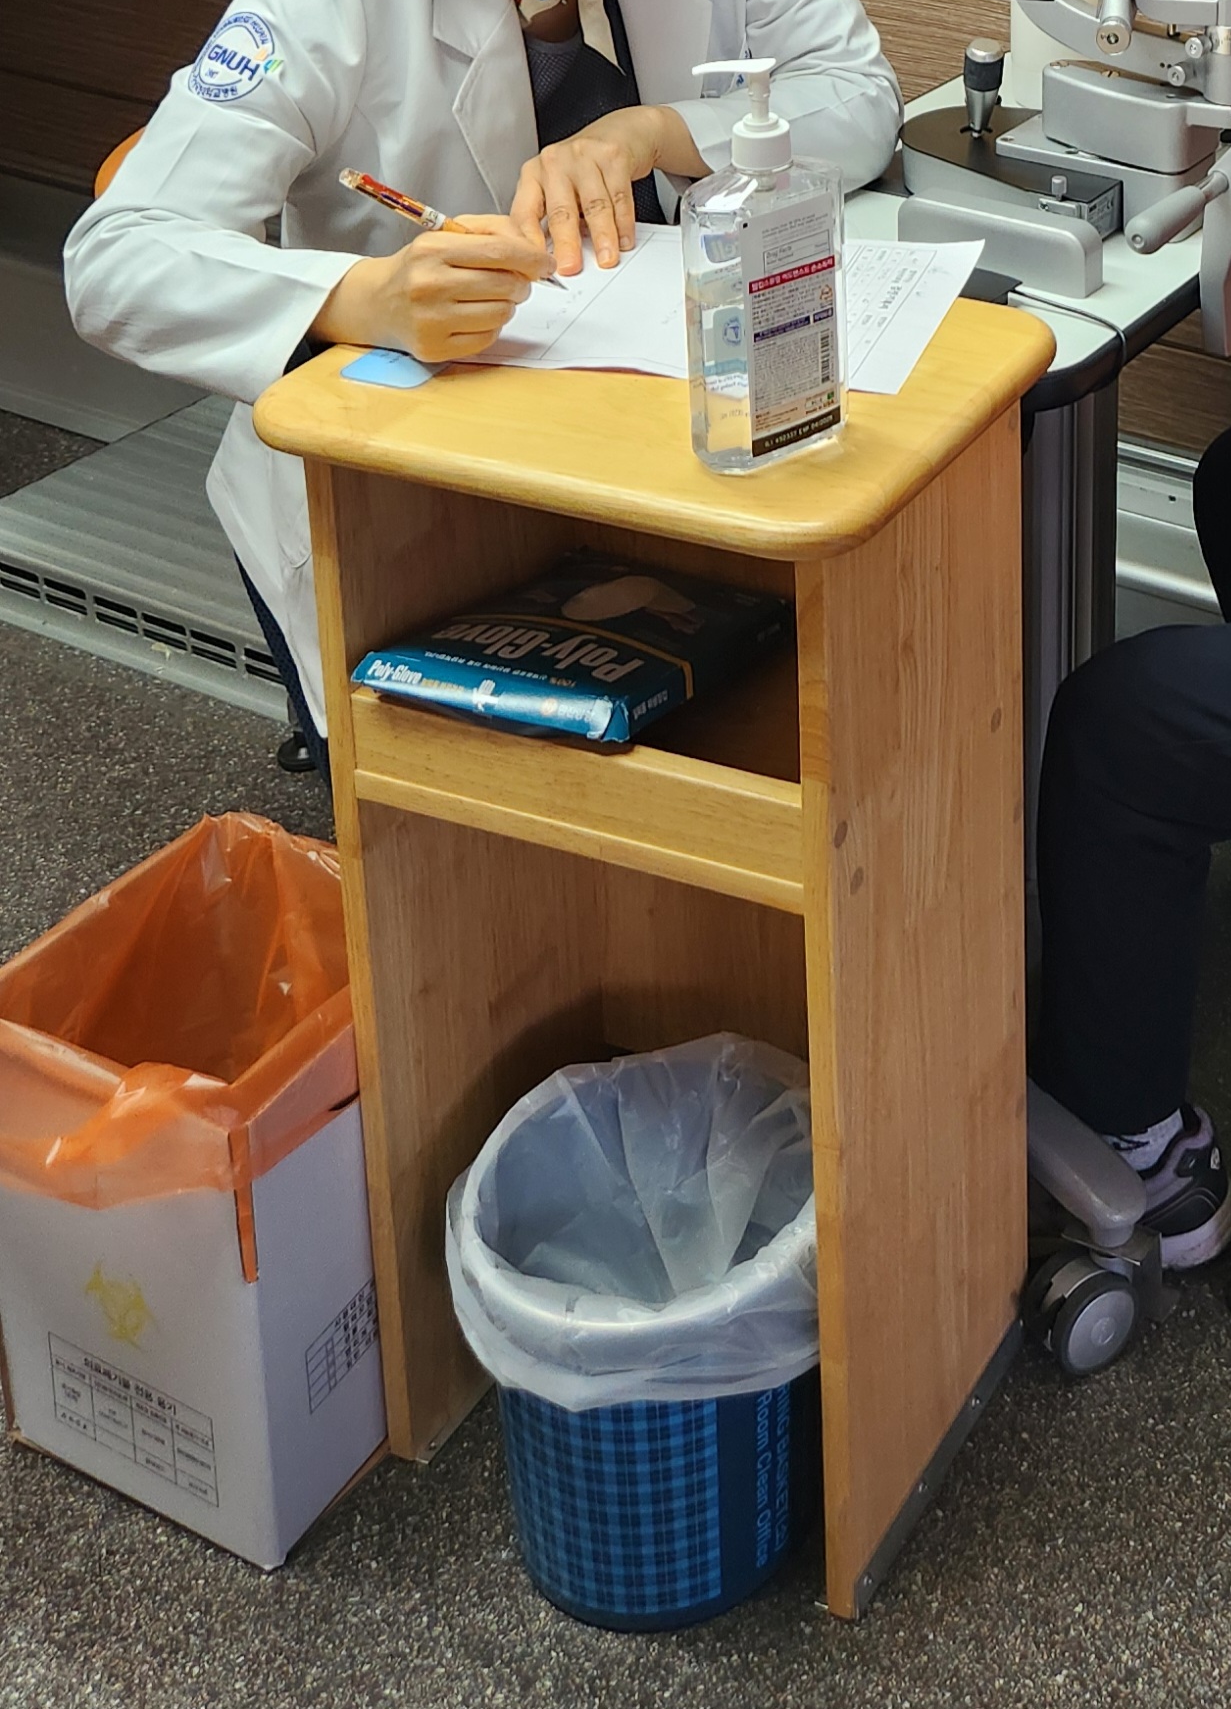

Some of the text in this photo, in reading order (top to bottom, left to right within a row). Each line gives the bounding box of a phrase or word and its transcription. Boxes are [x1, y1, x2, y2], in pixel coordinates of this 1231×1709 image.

[207, 44, 260, 82] GNUH
[366, 658, 423, 685] Poly-Glove
[431, 623, 645, 683] Poly-Glove
[757, 1389, 772, 1568] Room Clean Office
